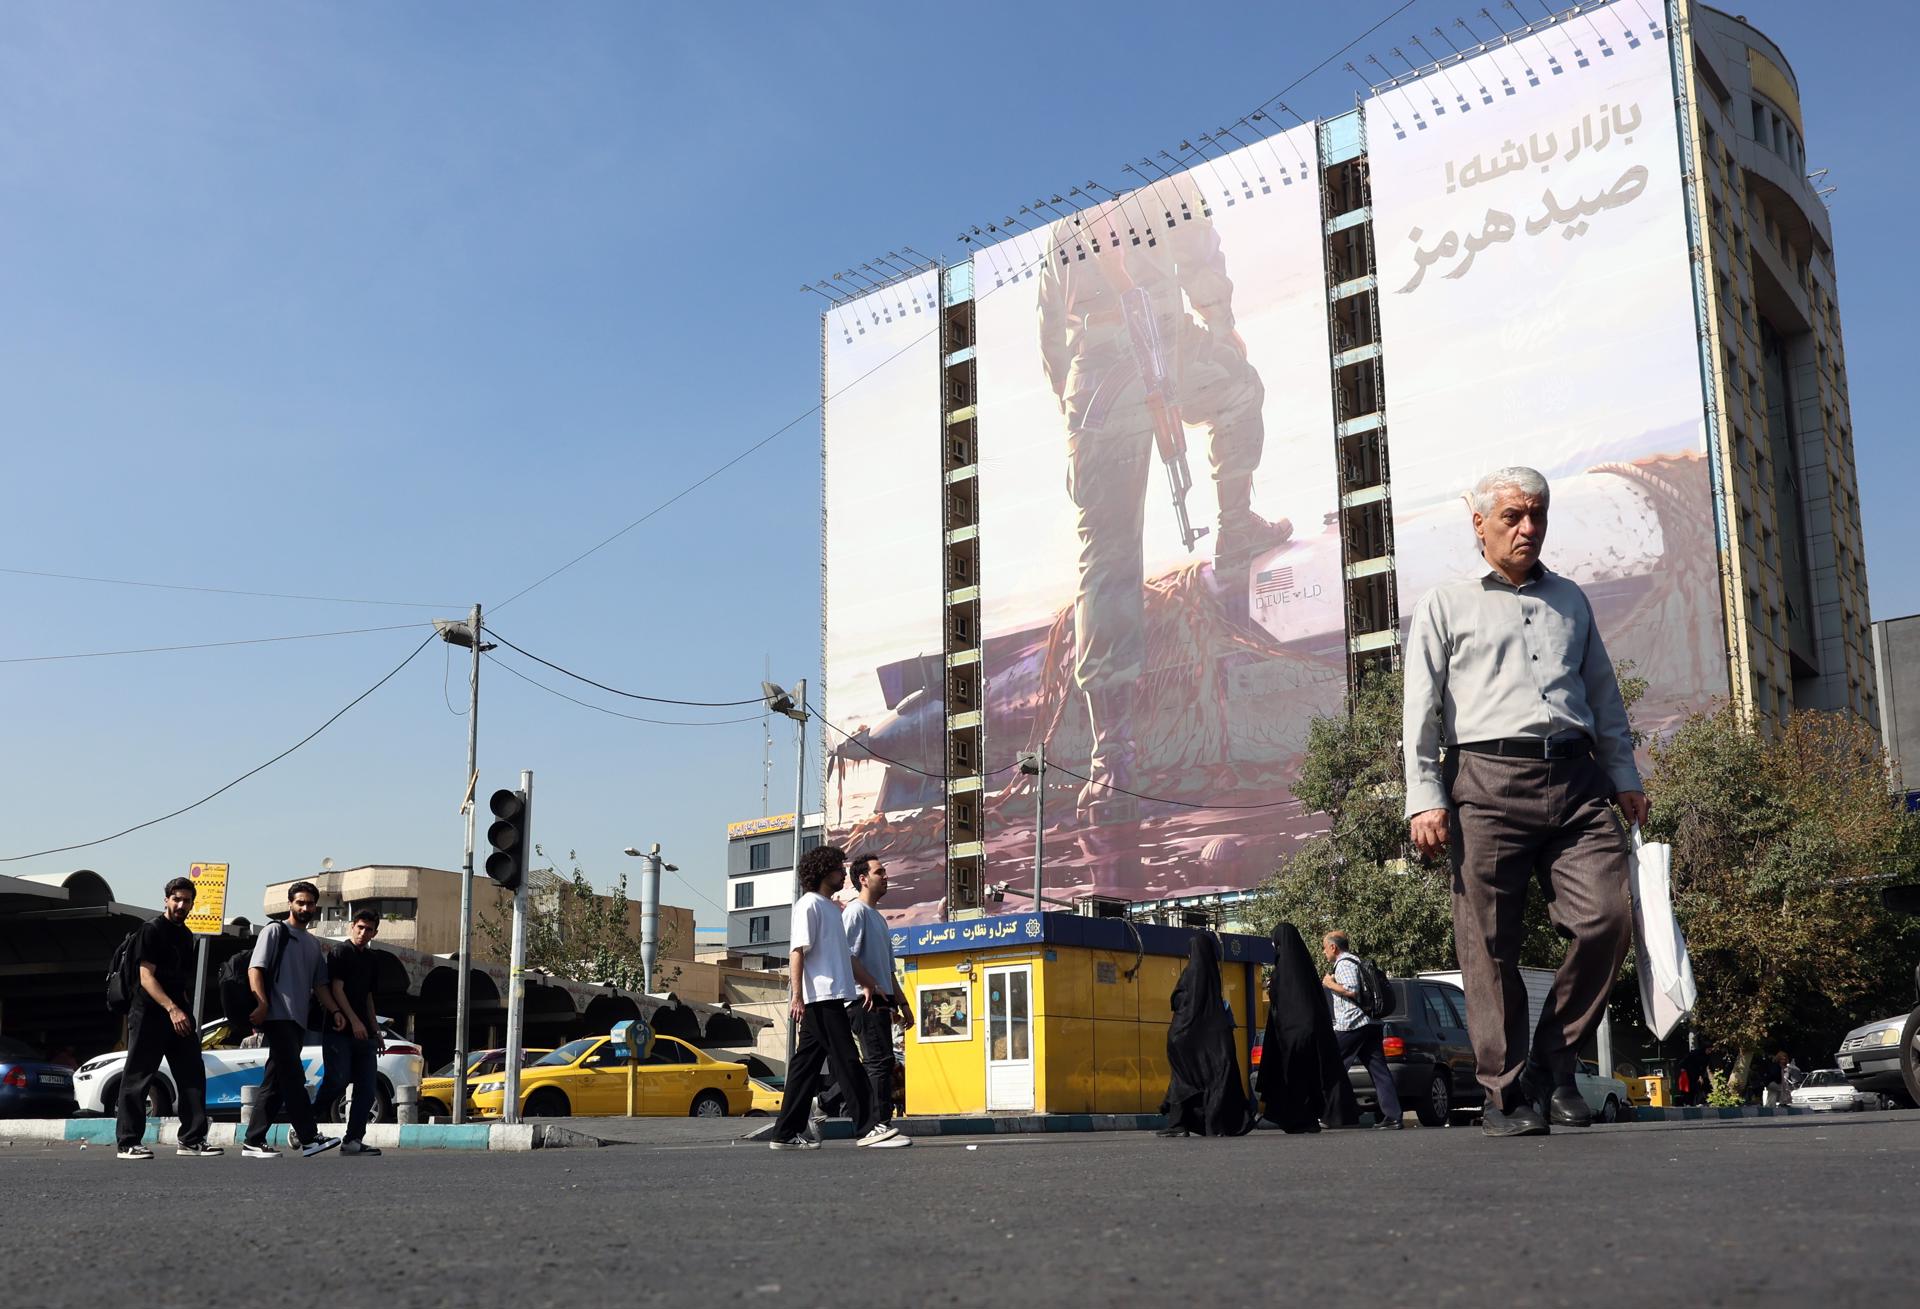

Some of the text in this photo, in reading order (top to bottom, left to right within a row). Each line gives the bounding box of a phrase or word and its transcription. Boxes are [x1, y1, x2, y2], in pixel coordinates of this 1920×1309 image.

[1444, 102, 1643, 194] بازار باشه!
[1392, 164, 1649, 295] صید هرمز
[918, 920, 1018, 946] کنترل و نظارت تاکسیرانی
